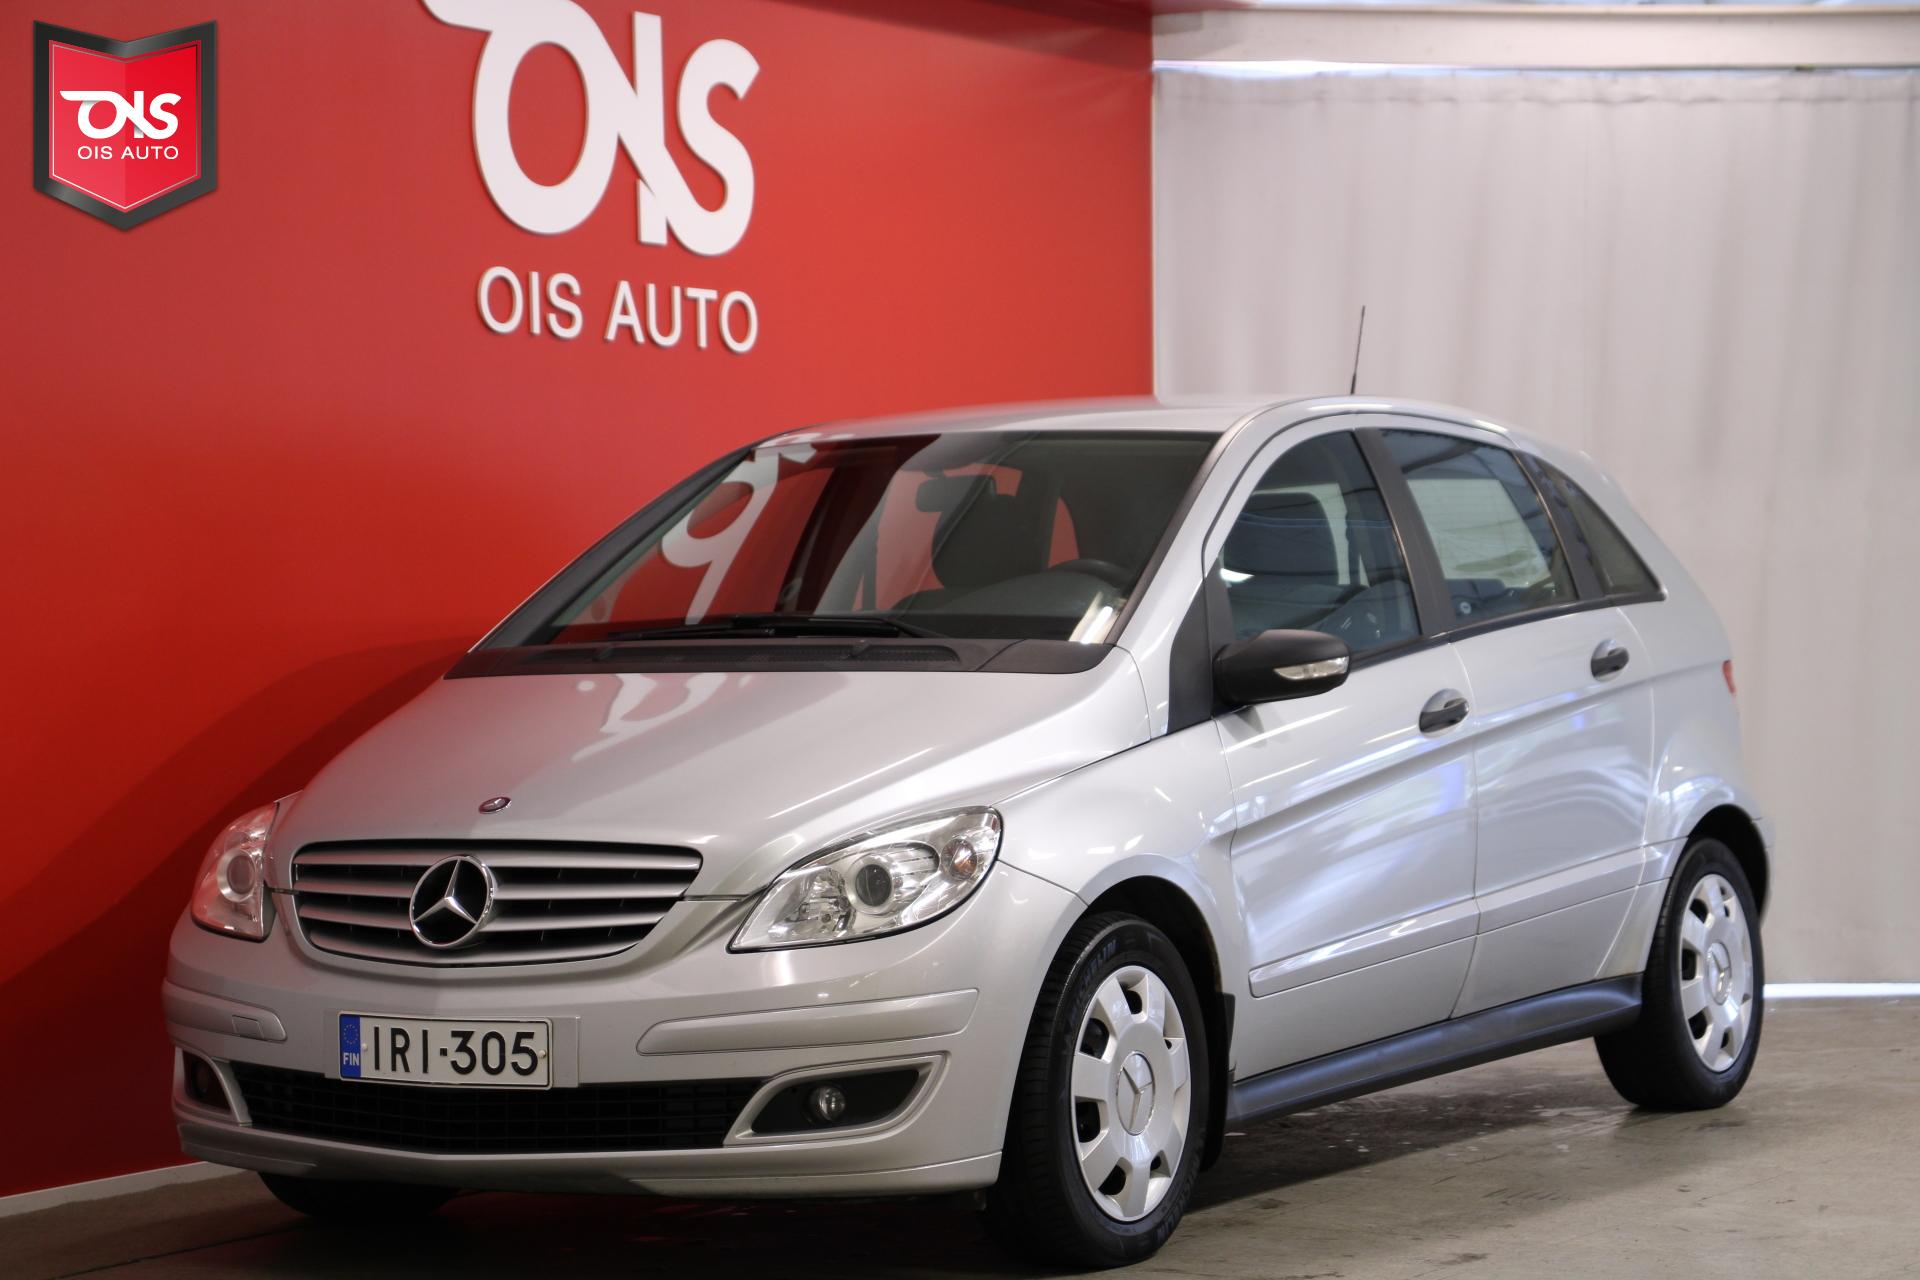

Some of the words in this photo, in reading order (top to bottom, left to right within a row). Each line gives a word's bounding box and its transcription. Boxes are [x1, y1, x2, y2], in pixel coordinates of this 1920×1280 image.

[477, 266, 583, 338] OIS
[604, 280, 758, 354] AUTO
[343, 1052, 360, 1067] FIN
[373, 1026, 538, 1076] IRI-305
